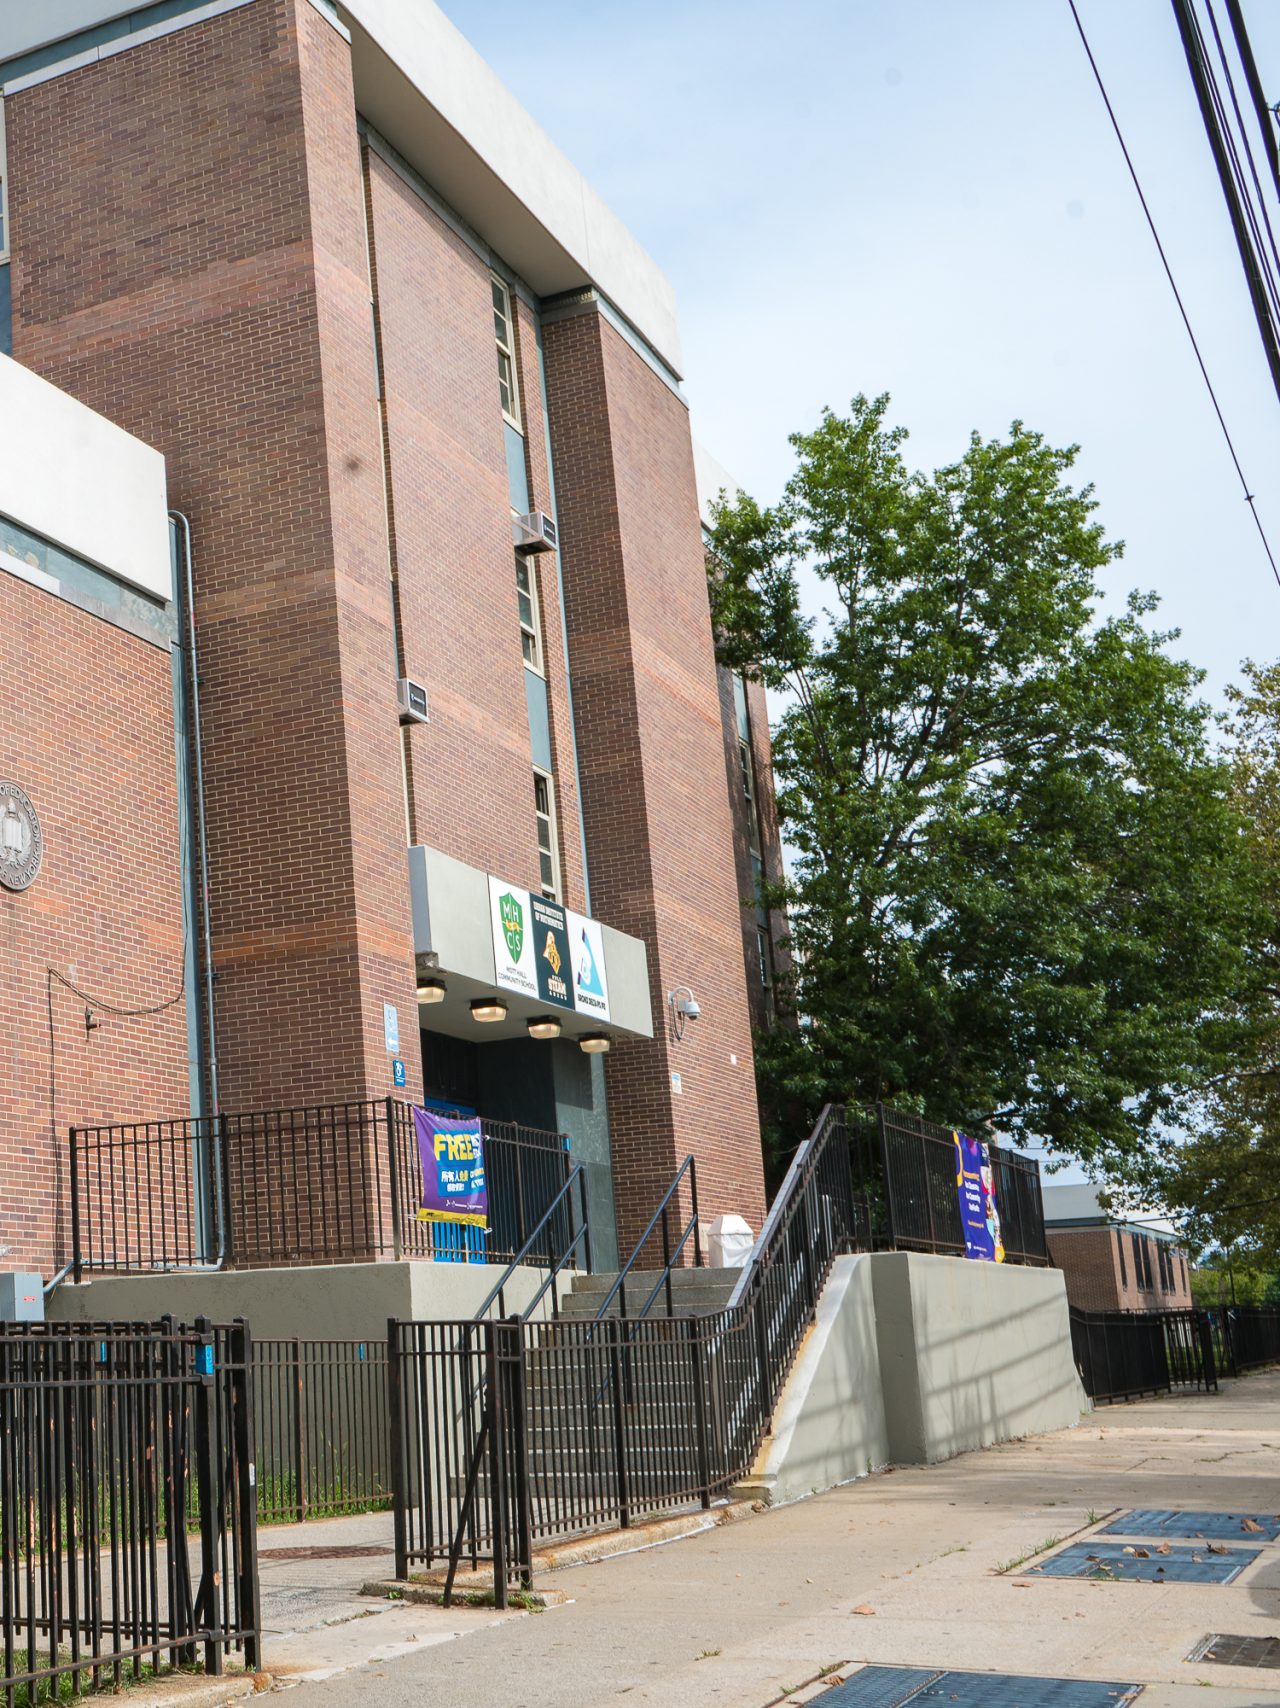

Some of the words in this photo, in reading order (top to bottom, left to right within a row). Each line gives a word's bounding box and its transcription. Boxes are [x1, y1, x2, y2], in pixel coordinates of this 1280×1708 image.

[0, 784, 10, 796] OF
[9, 786, 41, 842] EDUCATION
[7, 873, 27, 886] NEW
[24, 848, 41, 880] YORK
[434, 1134, 473, 1160] FREE
